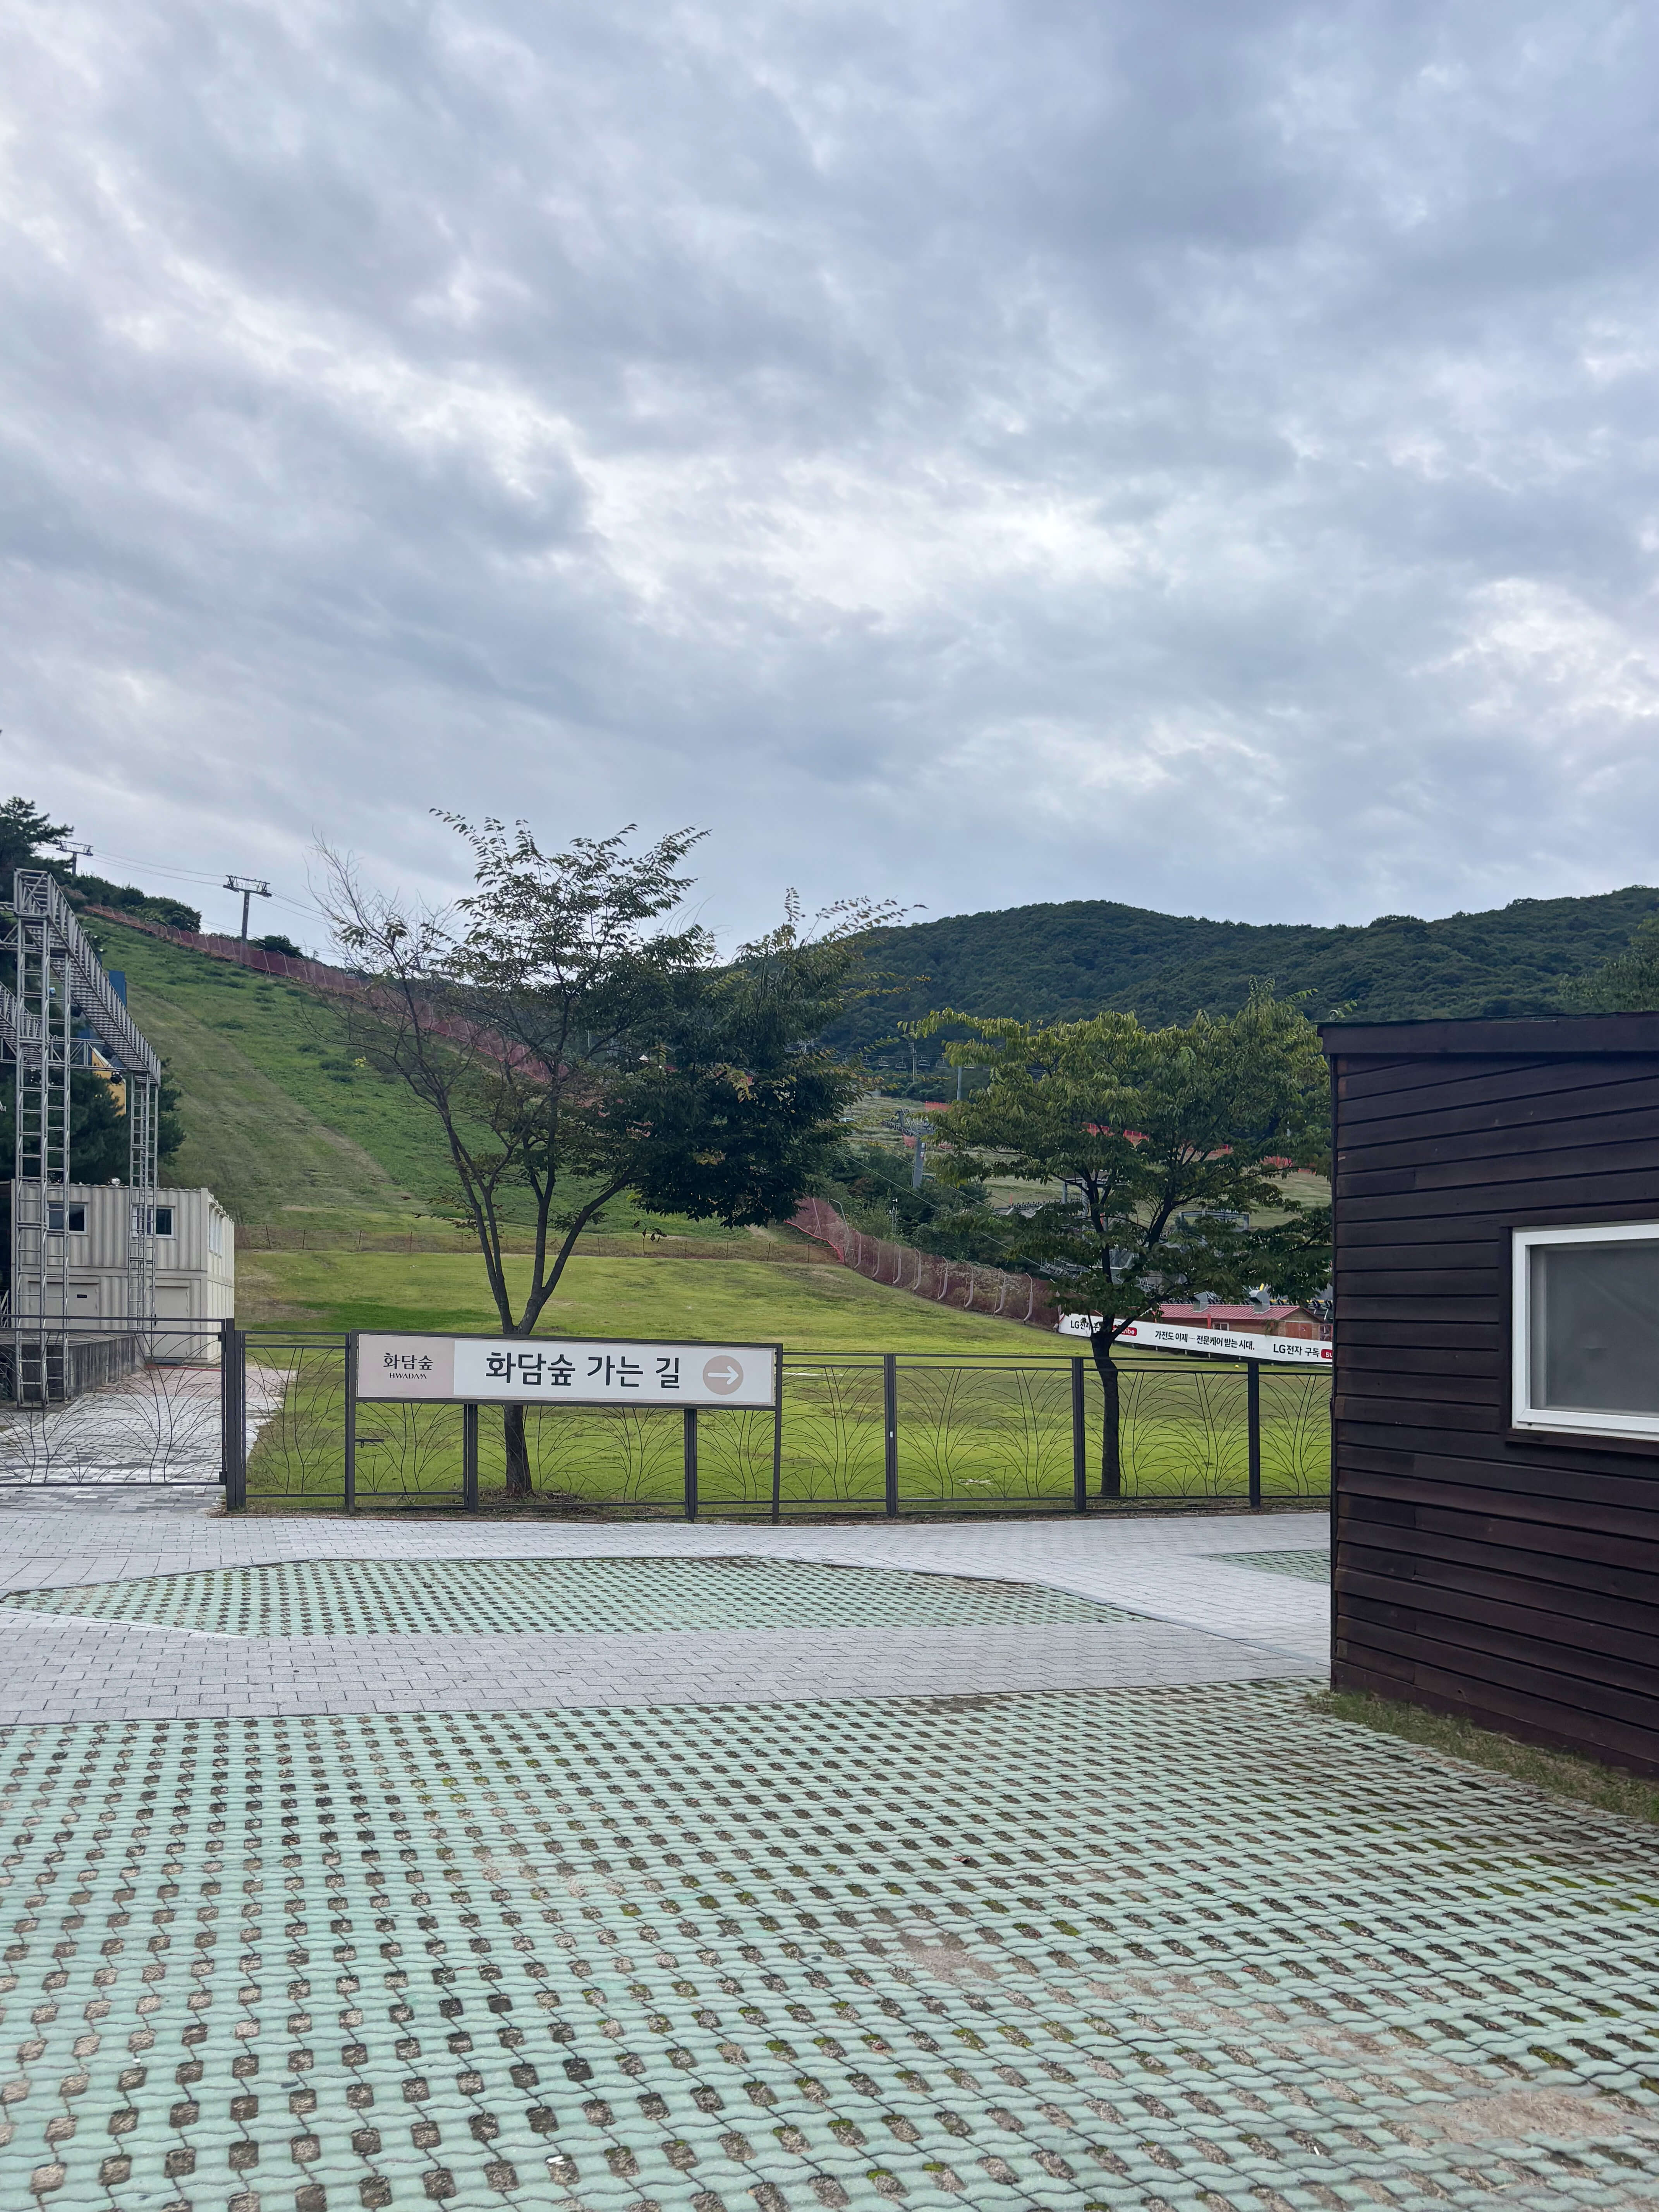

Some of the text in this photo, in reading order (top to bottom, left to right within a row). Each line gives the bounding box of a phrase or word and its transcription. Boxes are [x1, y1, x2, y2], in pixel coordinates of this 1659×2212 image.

[1155, 1331, 1174, 1340] 가전도
[1175, 1333, 1188, 1343] 이제
[1196, 1335, 1223, 1346] 전문케어
[1224, 1338, 1238, 1348] 받는
[1273, 1343, 1302, 1356] LG전자
[1304, 1347, 1320, 1358] 구독
[383, 1352, 433, 1370] 화담숲
[486, 1352, 680, 1389] 화담숲 가는 길
